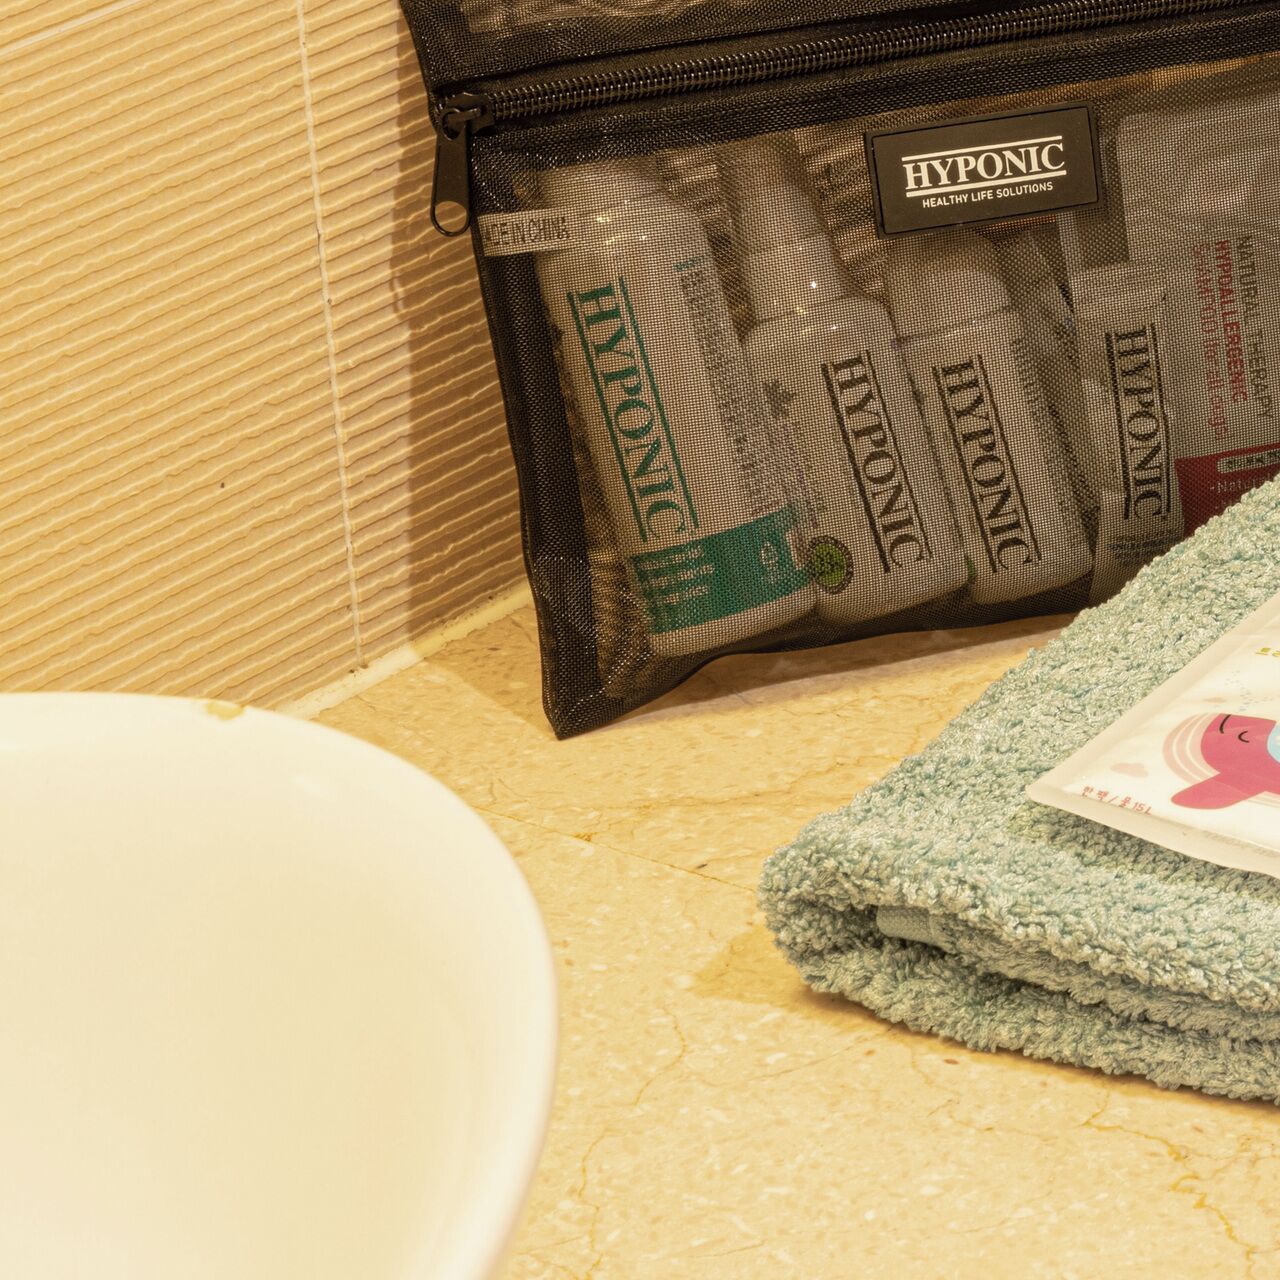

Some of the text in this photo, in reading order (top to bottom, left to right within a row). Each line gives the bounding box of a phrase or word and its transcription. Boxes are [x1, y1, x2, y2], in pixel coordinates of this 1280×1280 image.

[903, 143, 1065, 190] HYPONIC
[922, 181, 1053, 208] HEALTHY LIFE SOLUTIONS
[578, 282, 686, 538] HYPONIC
[1214, 240, 1247, 403] HYPOALLERGENIC
[1235, 236, 1273, 420] NATURAL THERAPY
[831, 354, 924, 568] HYPONIC
[941, 356, 1032, 570] HYPONIC
[1114, 326, 1163, 519] HYPONIC
